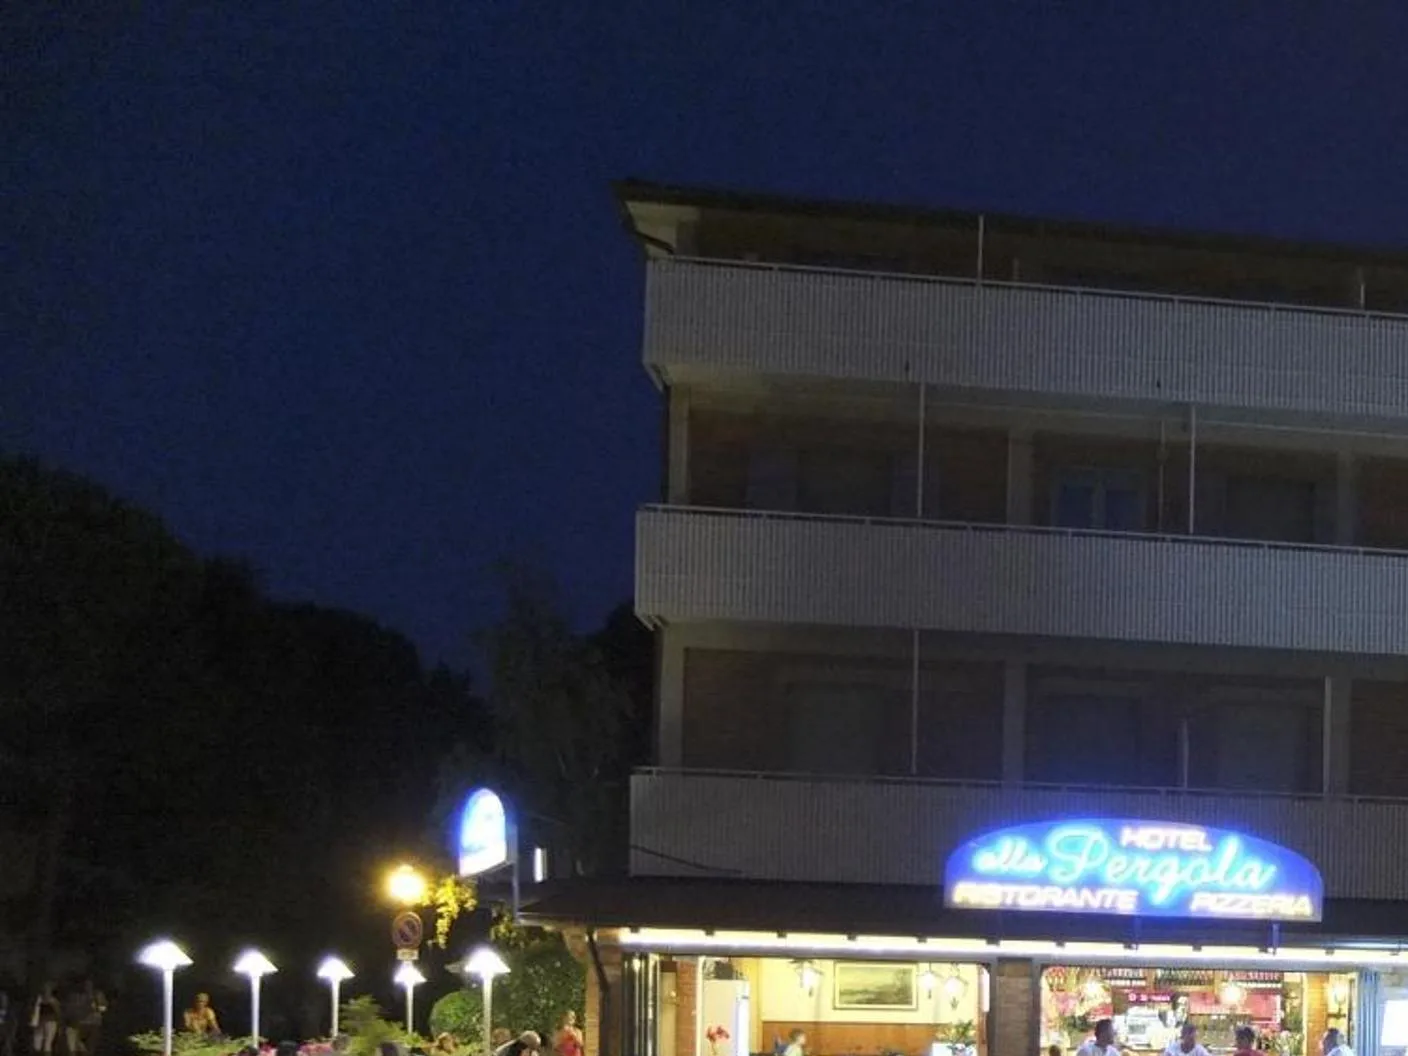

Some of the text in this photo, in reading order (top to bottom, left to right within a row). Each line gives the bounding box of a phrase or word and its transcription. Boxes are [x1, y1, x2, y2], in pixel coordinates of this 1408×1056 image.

[1119, 826, 1213, 851] HOTEL
[1048, 826, 1277, 905] Pergola
[953, 881, 1313, 916] RISTORANTE PIZZERIA
